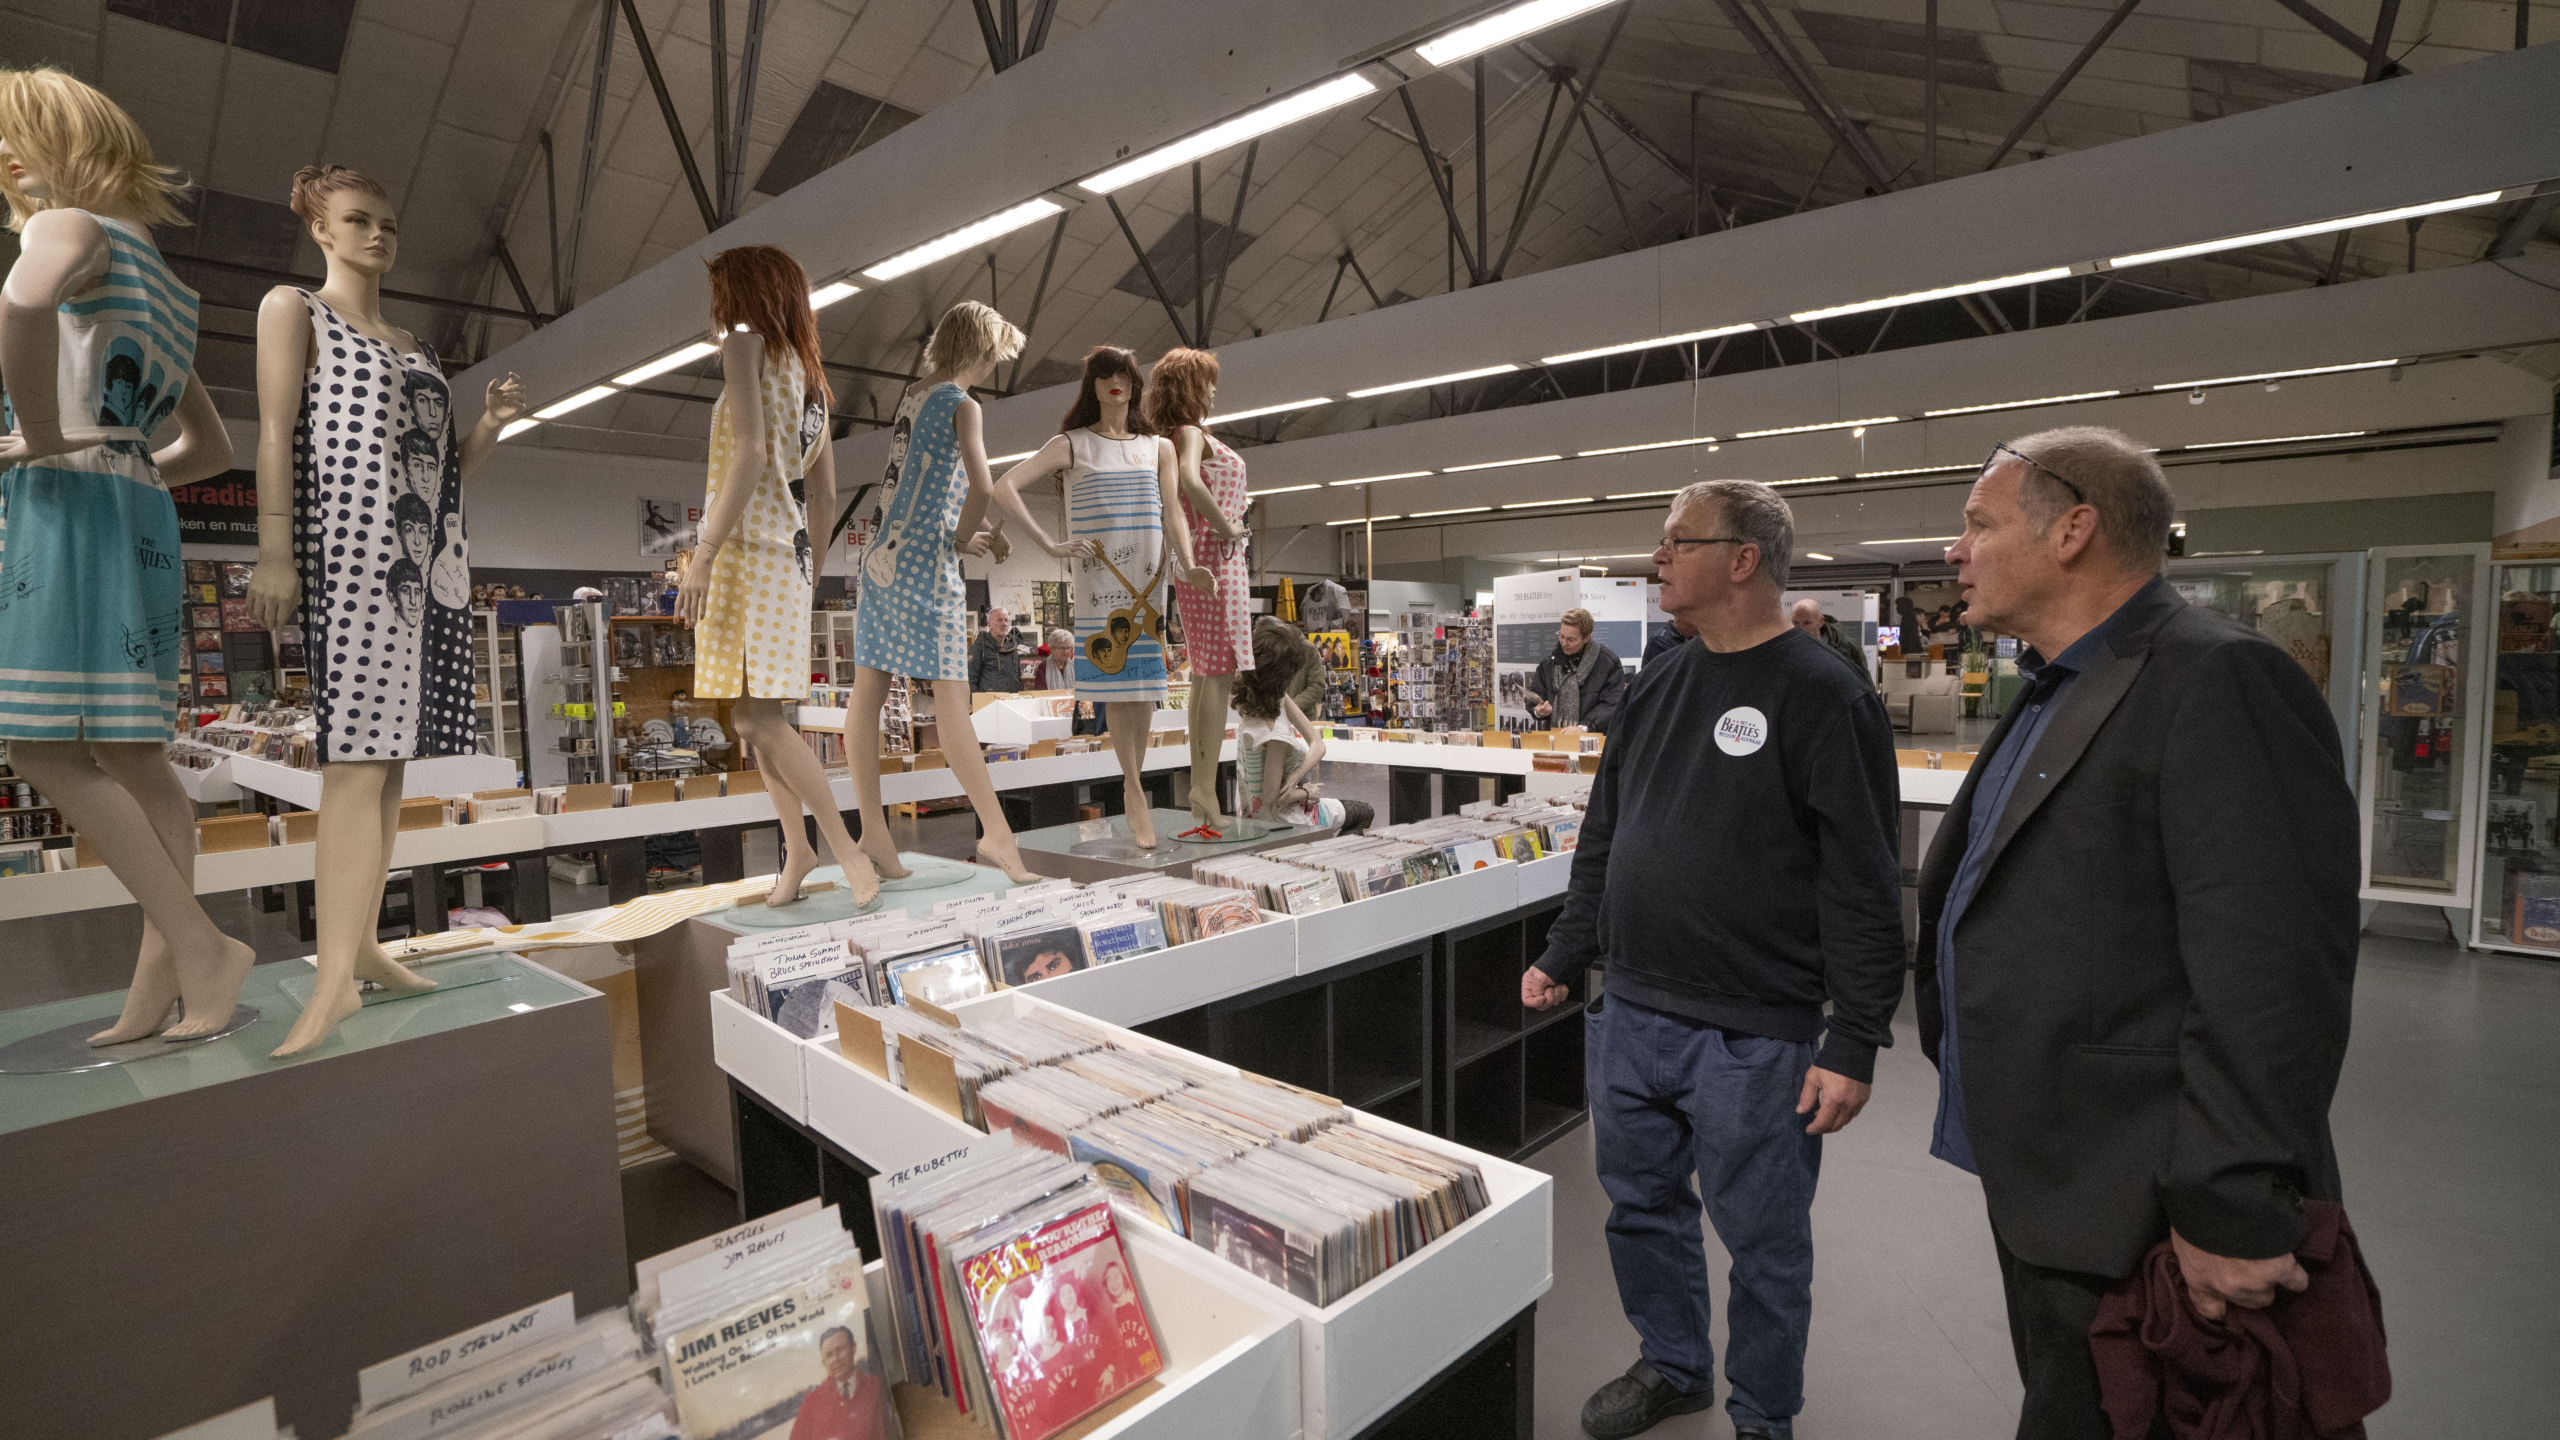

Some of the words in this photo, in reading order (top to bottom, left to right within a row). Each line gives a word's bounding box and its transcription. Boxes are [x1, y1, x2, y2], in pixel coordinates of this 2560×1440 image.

[209, 521, 227, 531] en
[846, 518, 856, 531] &
[1514, 593, 1523, 601] THE
[1524, 592, 1543, 600] BEATLES
[1590, 593, 1606, 602] Story
[1718, 731, 1736, 739] MUSEUM
[1721, 717, 1760, 739] BEATLES
[2531, 928, 2558, 939] BEATLES
[768, 965, 796, 980] BRUCE
[887, 1165, 911, 1189] THE
[913, 1147, 970, 1178] RUBETTES
[712, 1223, 766, 1251] RATTLES
[1037, 1234, 1081, 1262] REASON
[676, 1333, 718, 1364] JIM
[720, 1298, 797, 1344] REEVES
[681, 1353, 726, 1377] Waltzing
[728, 1345, 744, 1357] On
[765, 1329, 778, 1340] Of
[779, 1321, 797, 1334] The
[797, 1306, 826, 1325] World
[408, 1347, 451, 1379] ROD
[457, 1309, 541, 1359] STEWART
[691, 1370, 717, 1386] Love
[718, 1360, 738, 1374] You
